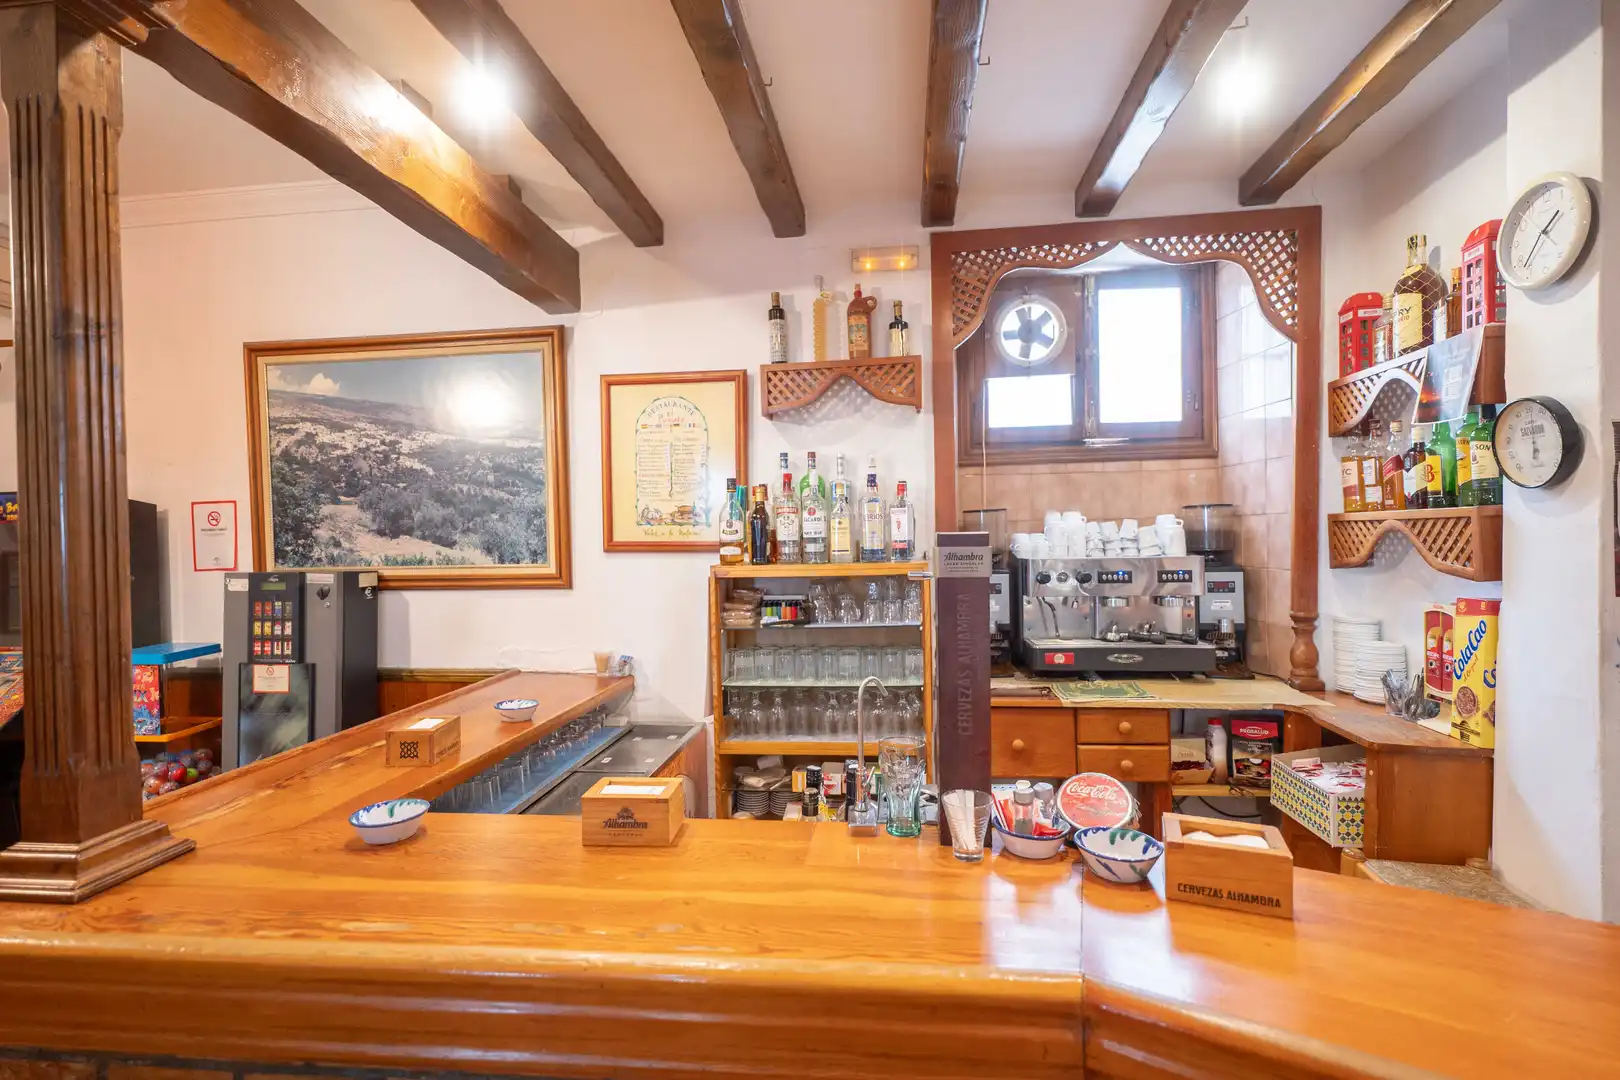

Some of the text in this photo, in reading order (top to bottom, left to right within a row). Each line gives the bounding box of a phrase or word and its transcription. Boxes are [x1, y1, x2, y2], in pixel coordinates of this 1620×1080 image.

[1520, 423, 1546, 438] SALVADOR
[943, 552, 984, 562] Alhambra
[956, 592, 973, 666] ALHAMBRA
[957, 668, 974, 736] CERVEZAS
[602, 817, 648, 829] Alhambra
[1177, 882, 1282, 909] CERVEZAS ALHAMBRA
